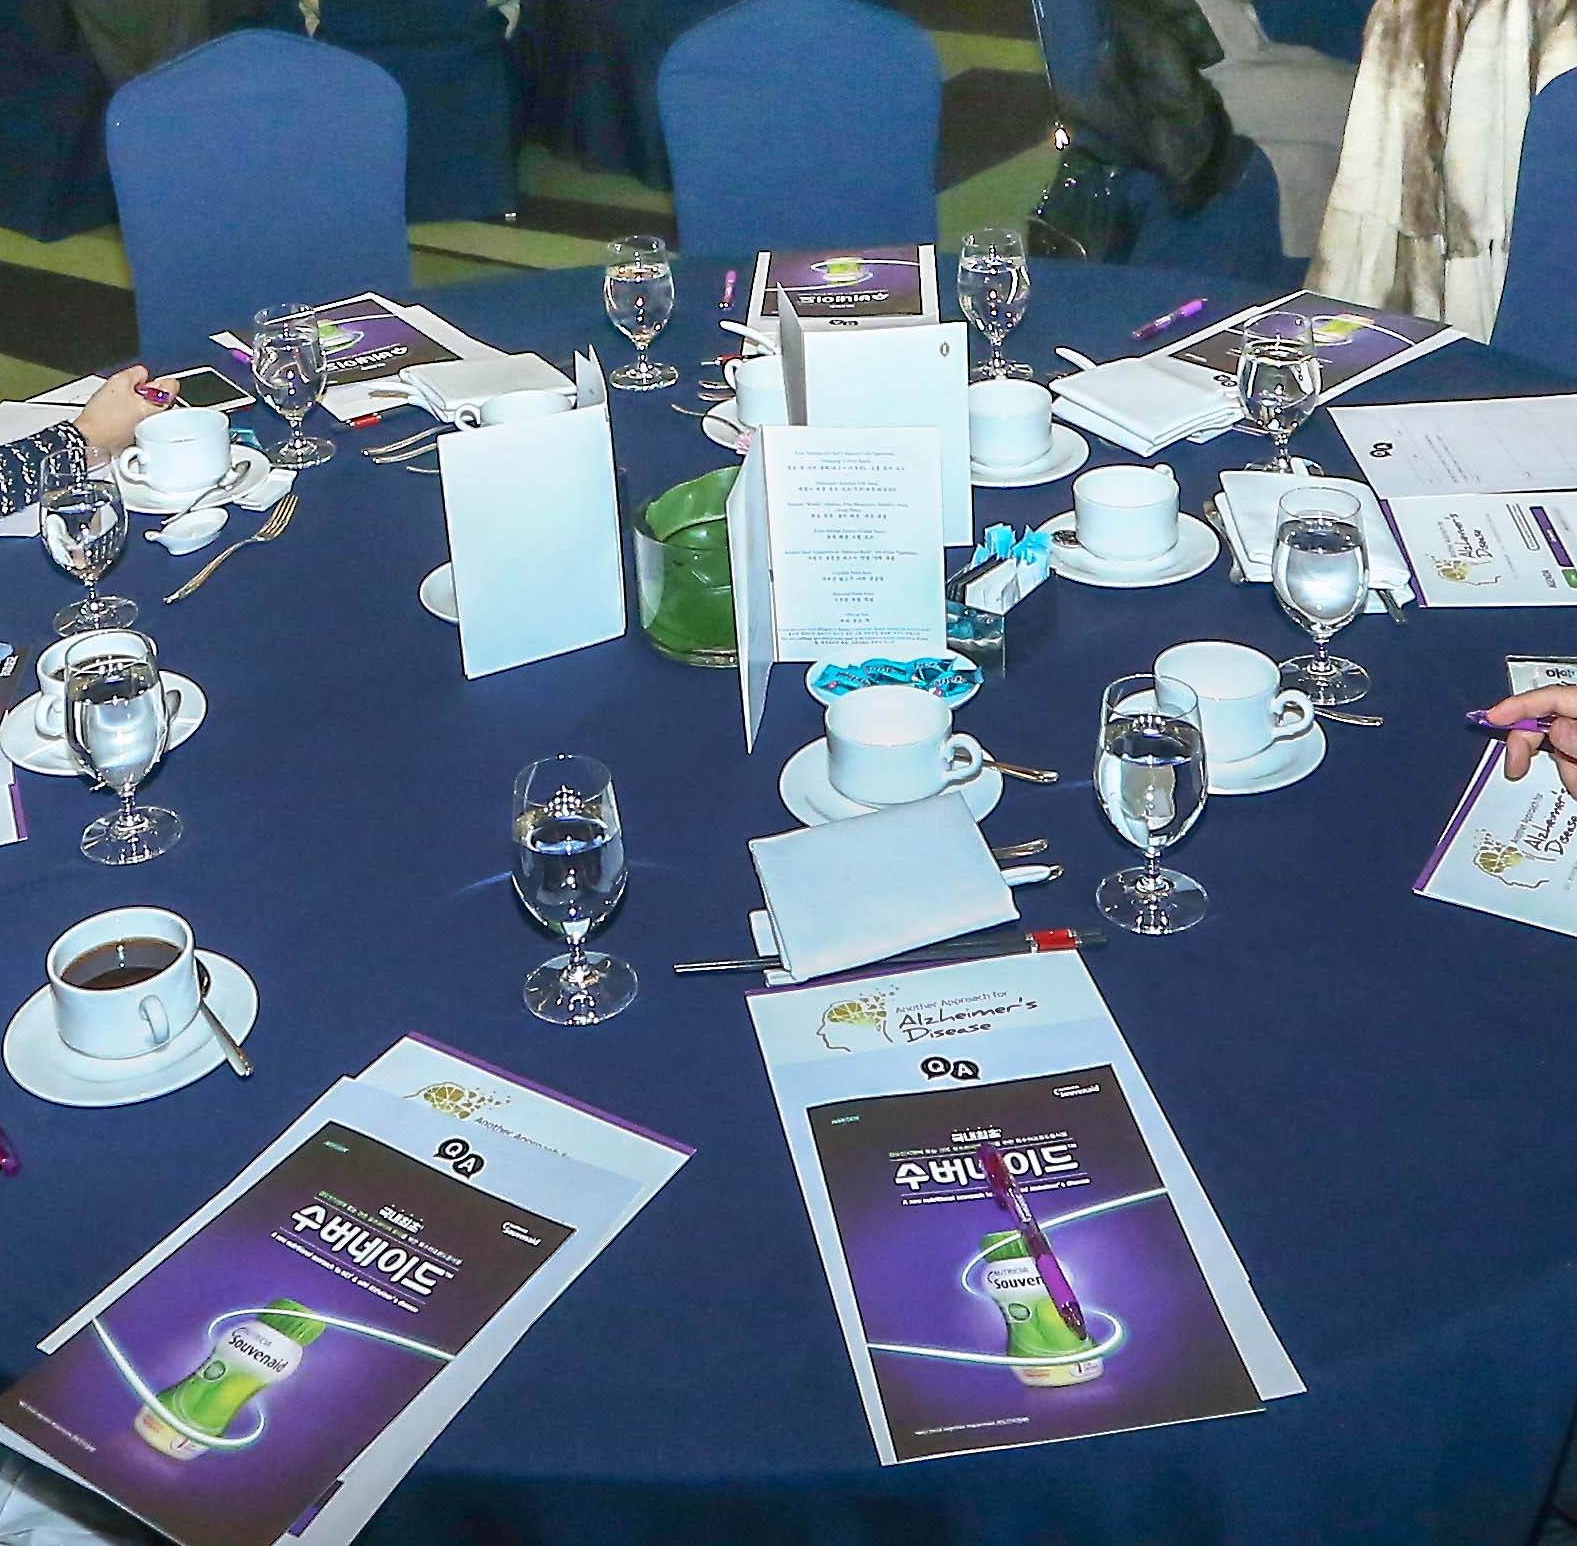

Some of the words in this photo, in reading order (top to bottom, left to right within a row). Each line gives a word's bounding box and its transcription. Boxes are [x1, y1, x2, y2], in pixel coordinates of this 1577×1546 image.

[896, 1001, 937, 1014] Another
[992, 990, 1007, 998] for
[899, 996, 1038, 1029] Alzheimer's
[902, 1022, 992, 1043] Disease
[228, 1333, 289, 1373] Souvenaid
